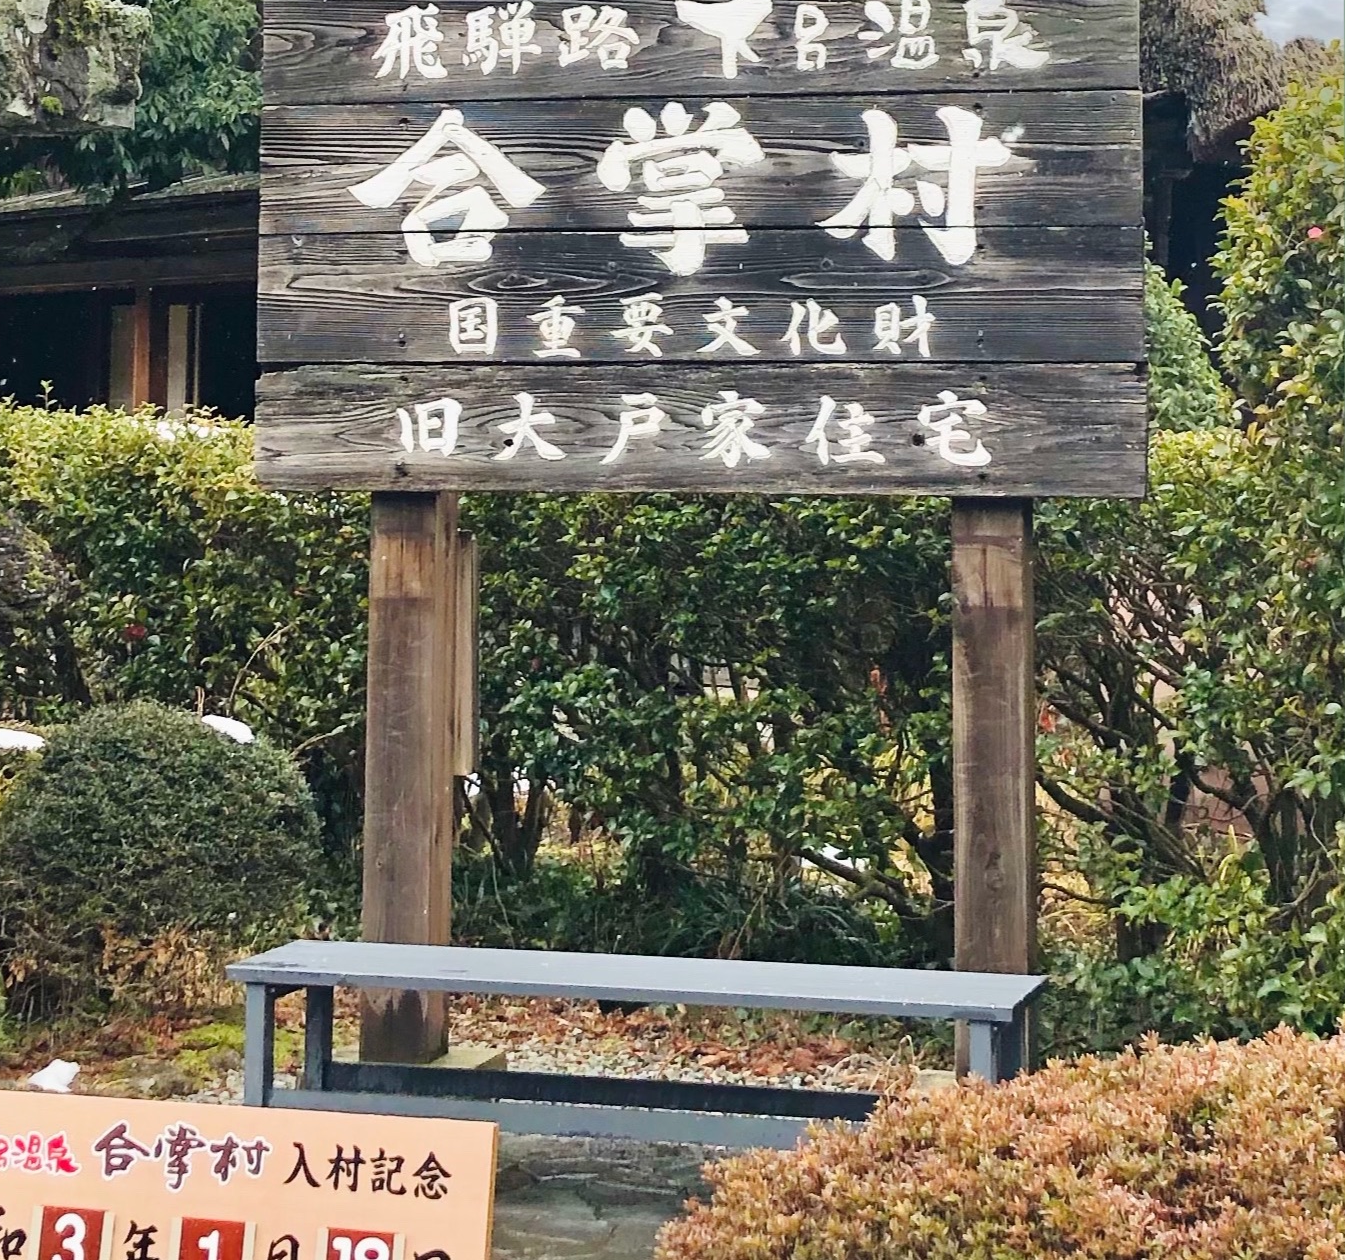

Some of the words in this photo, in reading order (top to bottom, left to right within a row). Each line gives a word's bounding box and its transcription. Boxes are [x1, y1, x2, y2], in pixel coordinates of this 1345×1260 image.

[346, 101, 1023, 277] 合掌村
[448, 293, 936, 358] 国重要文化財
[397, 390, 992, 469] 旧大戸家住宅
